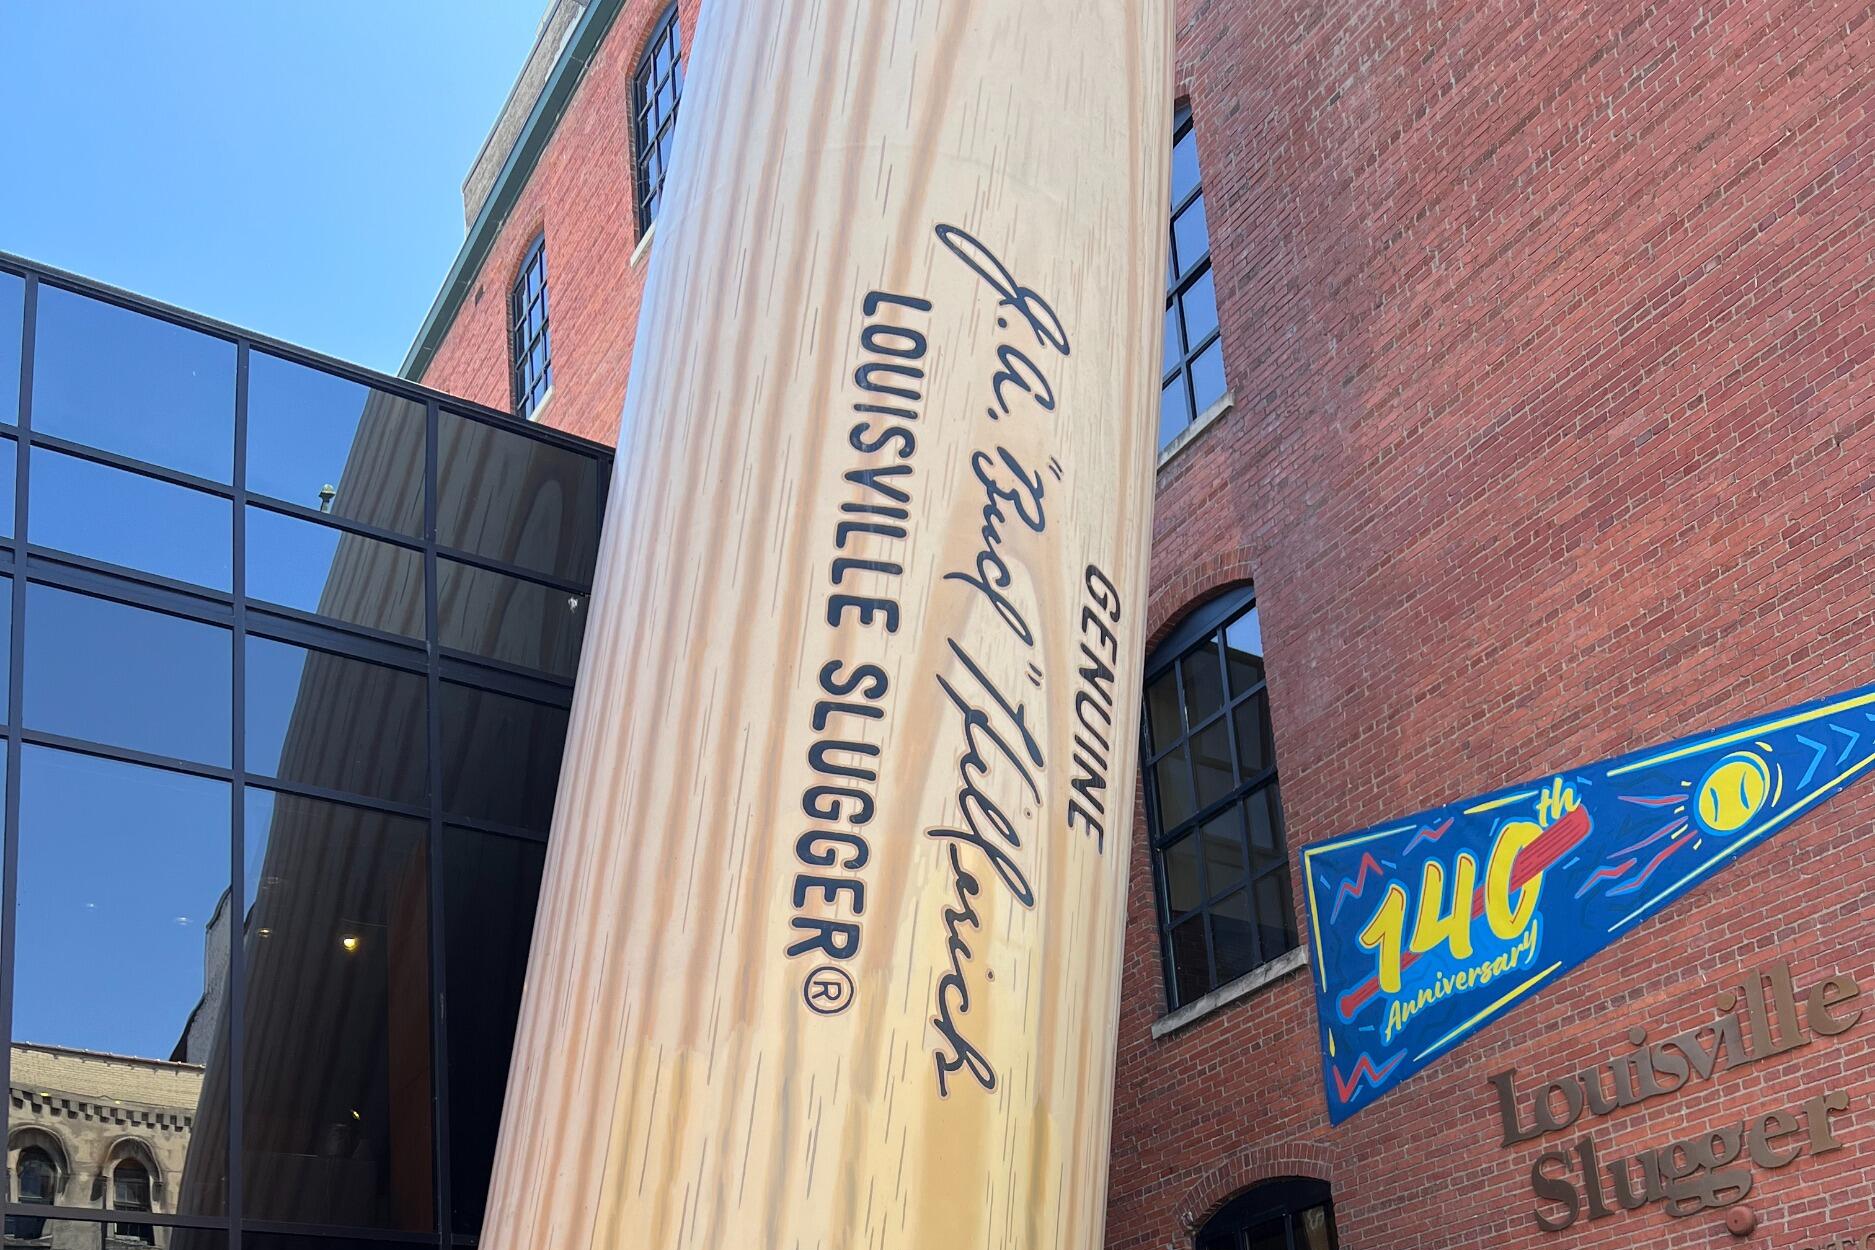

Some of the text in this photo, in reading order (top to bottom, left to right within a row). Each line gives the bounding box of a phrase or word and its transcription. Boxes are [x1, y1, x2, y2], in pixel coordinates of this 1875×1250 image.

[827, 291, 932, 633] LOUISVILLE
[1067, 564, 1121, 855] GENUINE
[927, 637, 1044, 1097] Hillerich
[1386, 919, 1538, 1042] Anniversary
[1487, 960, 1863, 1148] Louisville
[1531, 1089, 1850, 1232] Slugger
